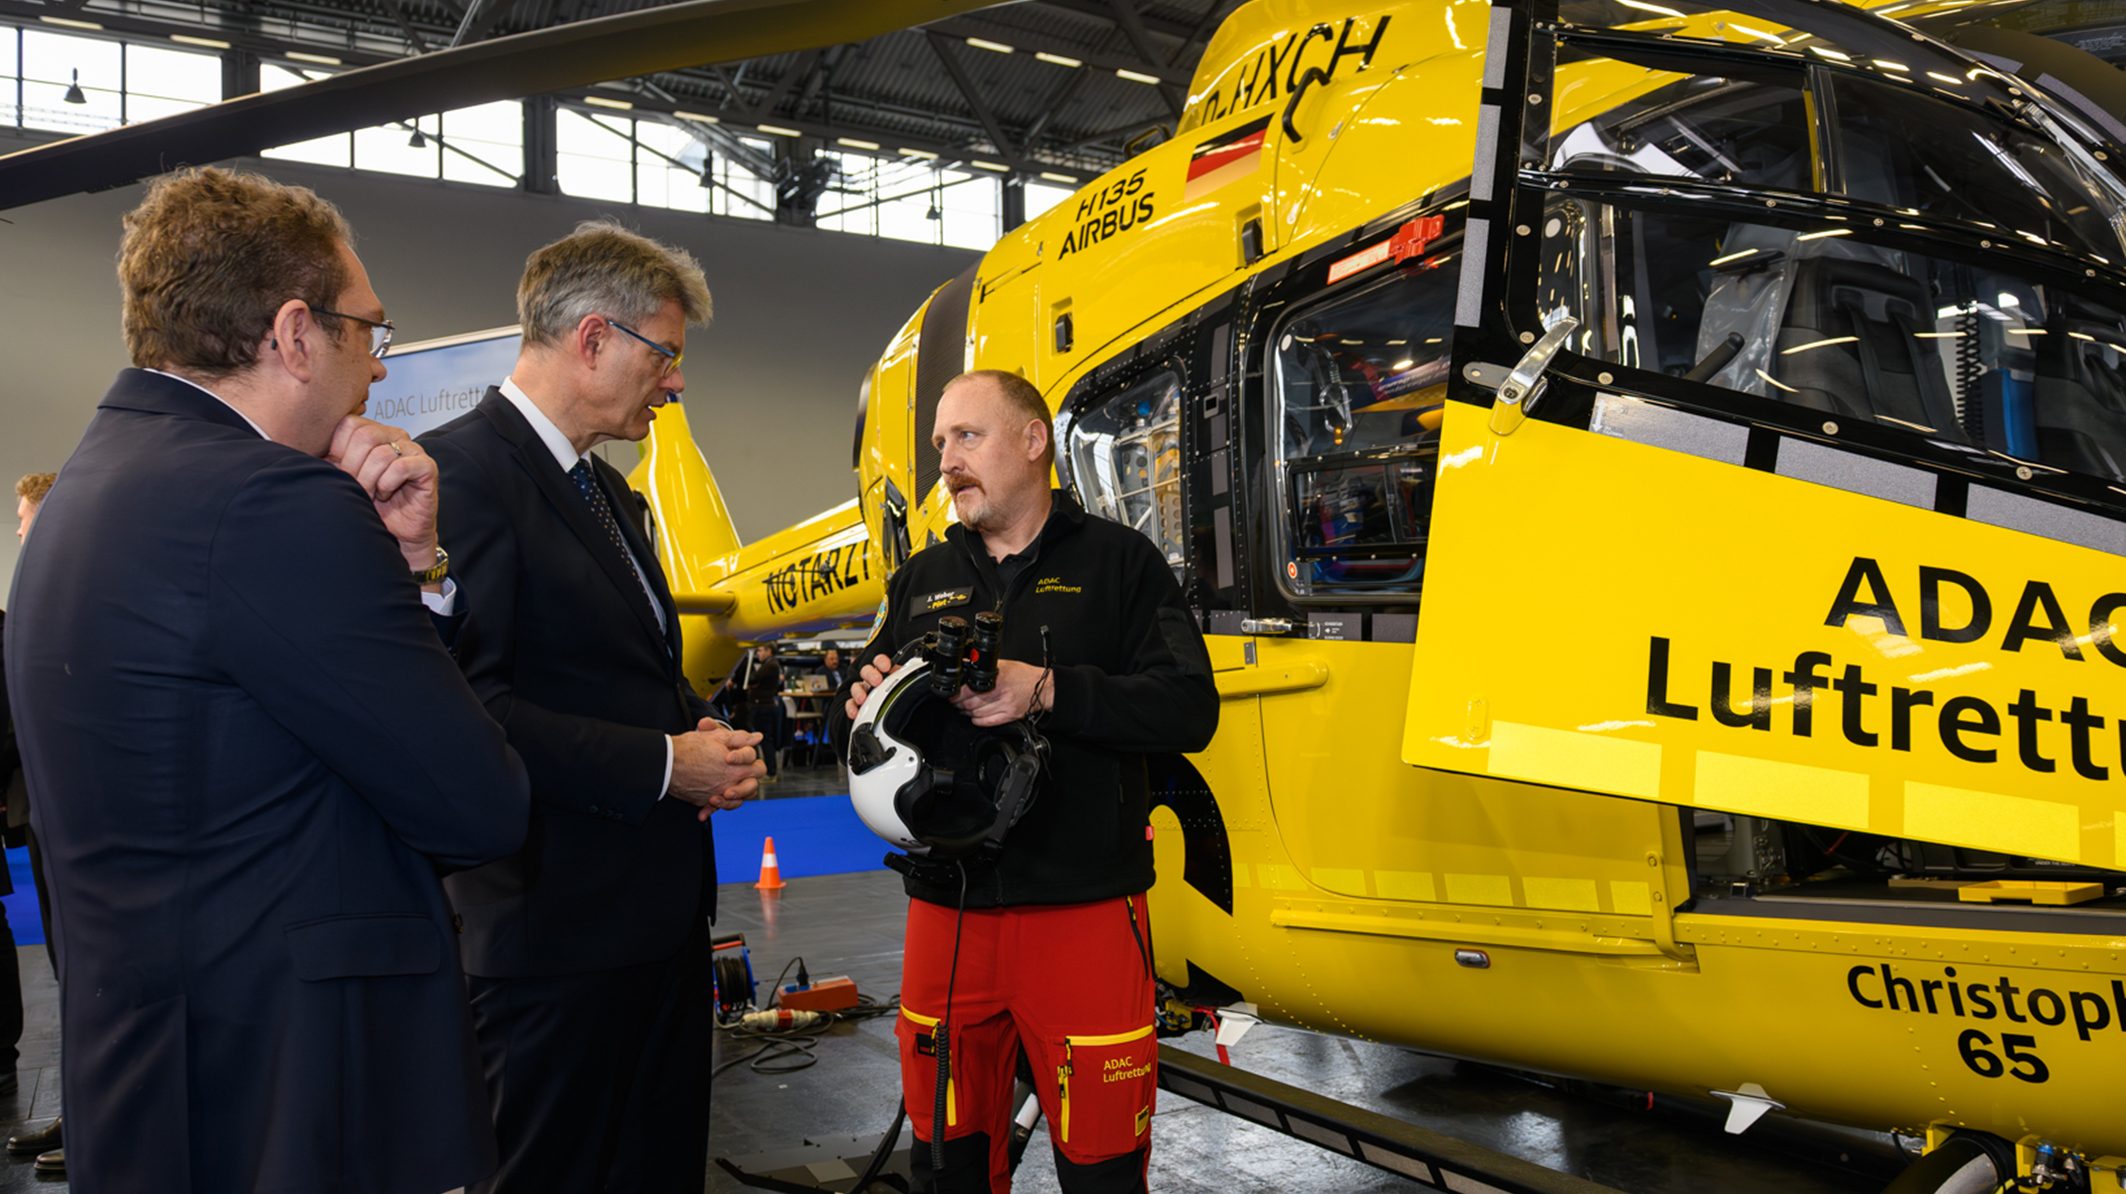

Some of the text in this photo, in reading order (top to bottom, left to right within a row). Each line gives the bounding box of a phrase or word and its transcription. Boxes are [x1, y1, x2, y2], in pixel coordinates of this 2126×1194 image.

[1075, 168, 1148, 222] H135
[1057, 192, 1155, 260] AIRBUS
[374, 386, 484, 419] ADAC Luftrett
[1035, 585, 1082, 594] Luftrettung
[1037, 577, 1060, 585] ADAC
[1646, 636, 2126, 781] Luftrett
[1103, 1056, 1133, 1071] ADAC
[1957, 1028, 2050, 1084] 65
